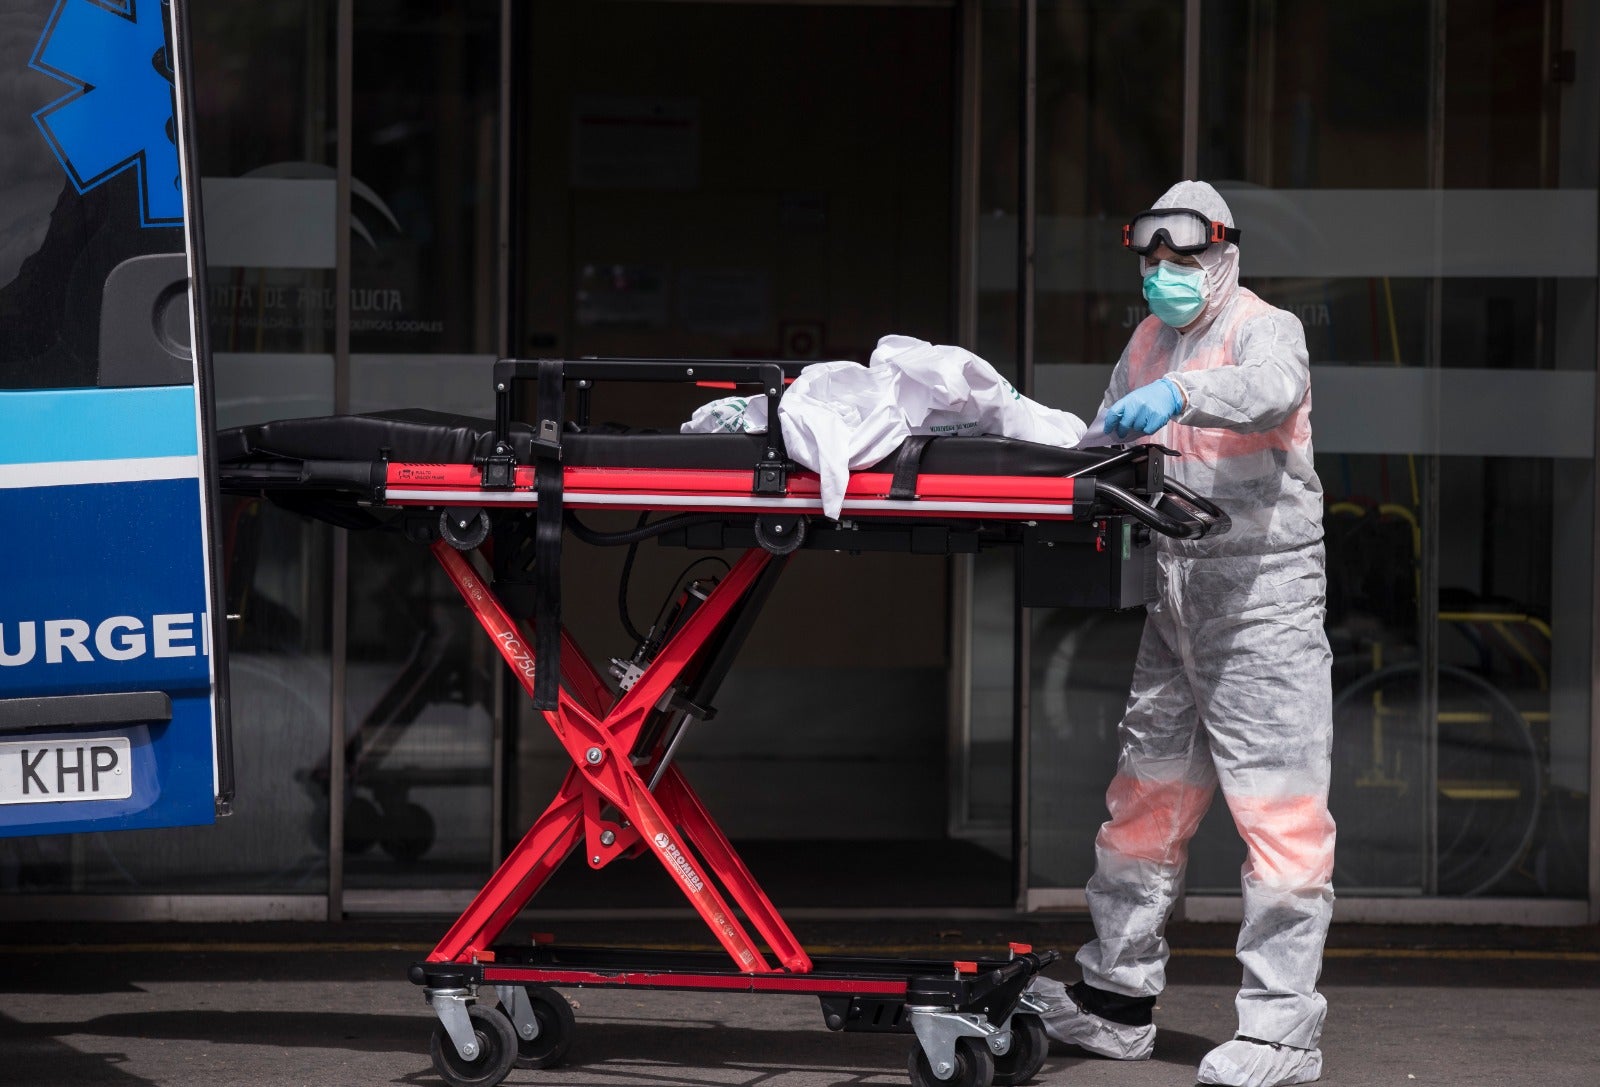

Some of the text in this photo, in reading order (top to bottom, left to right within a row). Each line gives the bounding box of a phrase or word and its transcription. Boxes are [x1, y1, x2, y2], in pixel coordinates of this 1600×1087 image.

[265, 288, 288, 309] DE
[0, 612, 209, 667] URGE
[21, 745, 119, 794] KHP
[667, 843, 704, 892] PROMEBA
